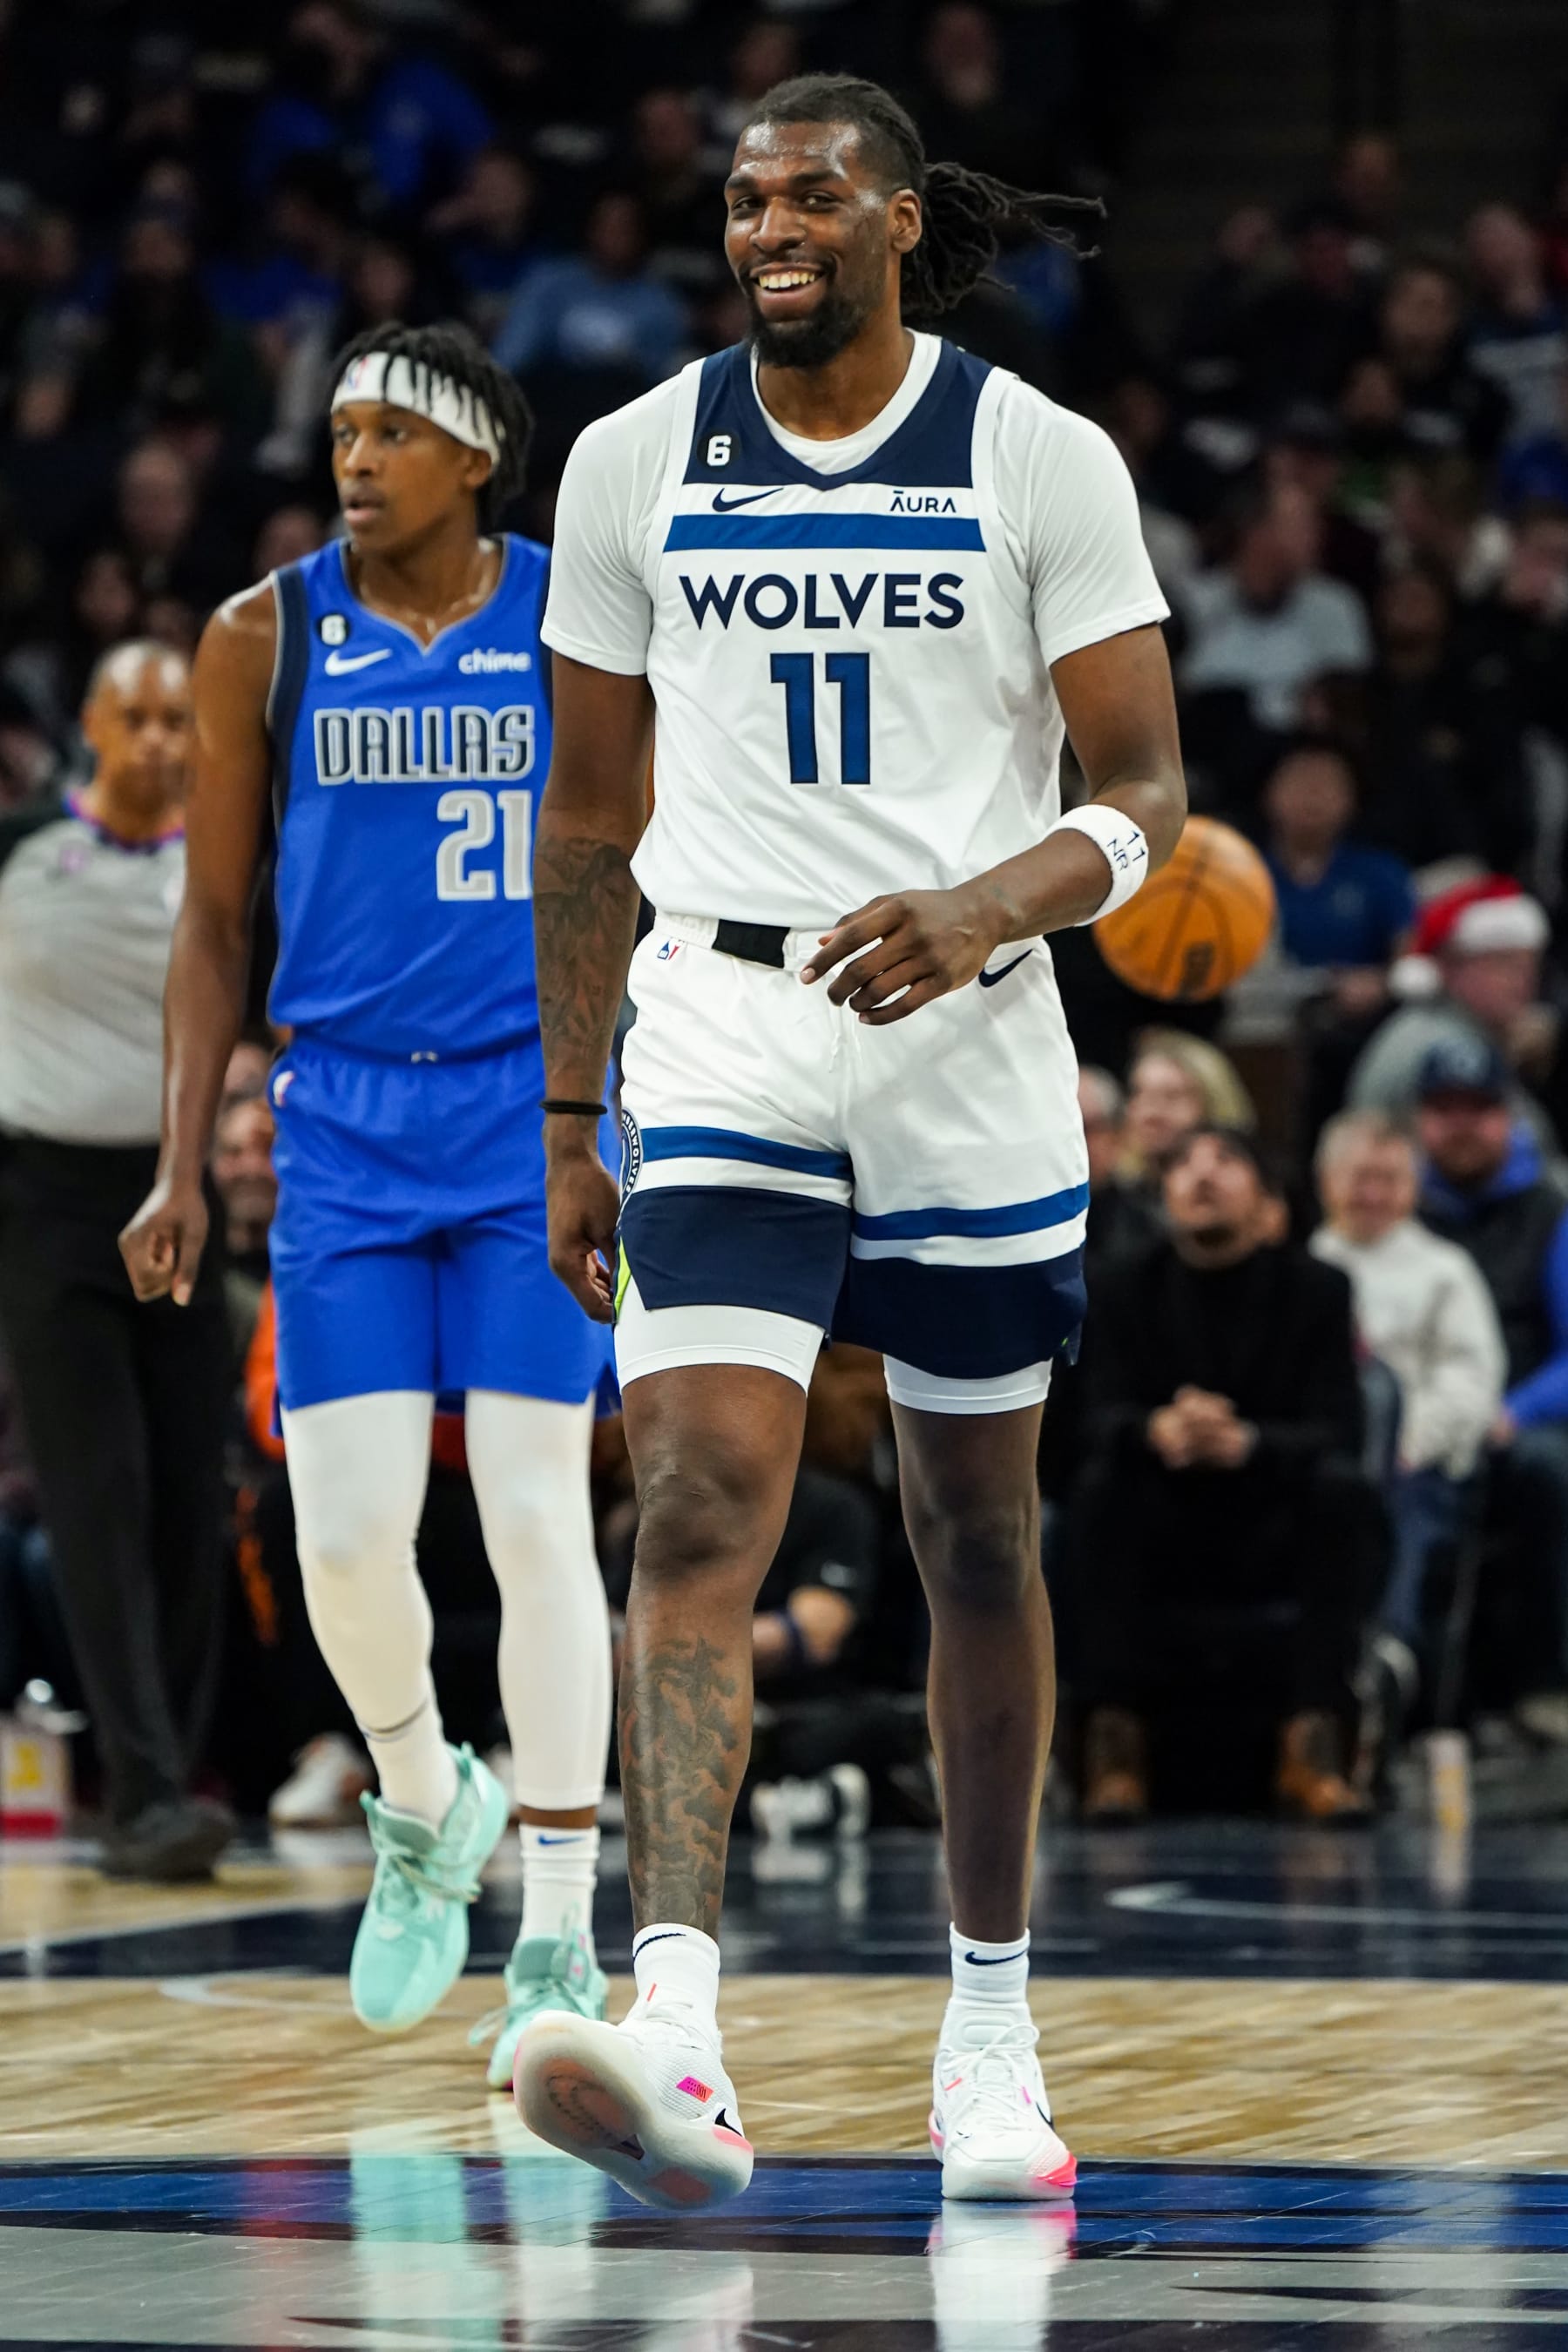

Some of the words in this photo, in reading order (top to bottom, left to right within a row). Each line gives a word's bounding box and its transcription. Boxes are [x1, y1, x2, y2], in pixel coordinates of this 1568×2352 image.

[706, 435, 732, 467] 6
[679, 572, 965, 631] WOLVES
[321, 614, 346, 645] 6
[458, 647, 531, 675] chime
[770, 652, 871, 785] 11
[314, 704, 536, 786] DALLAS
[436, 789, 532, 902] 21
[1106, 838, 1129, 872] NR
[1126, 829, 1146, 862] 11
